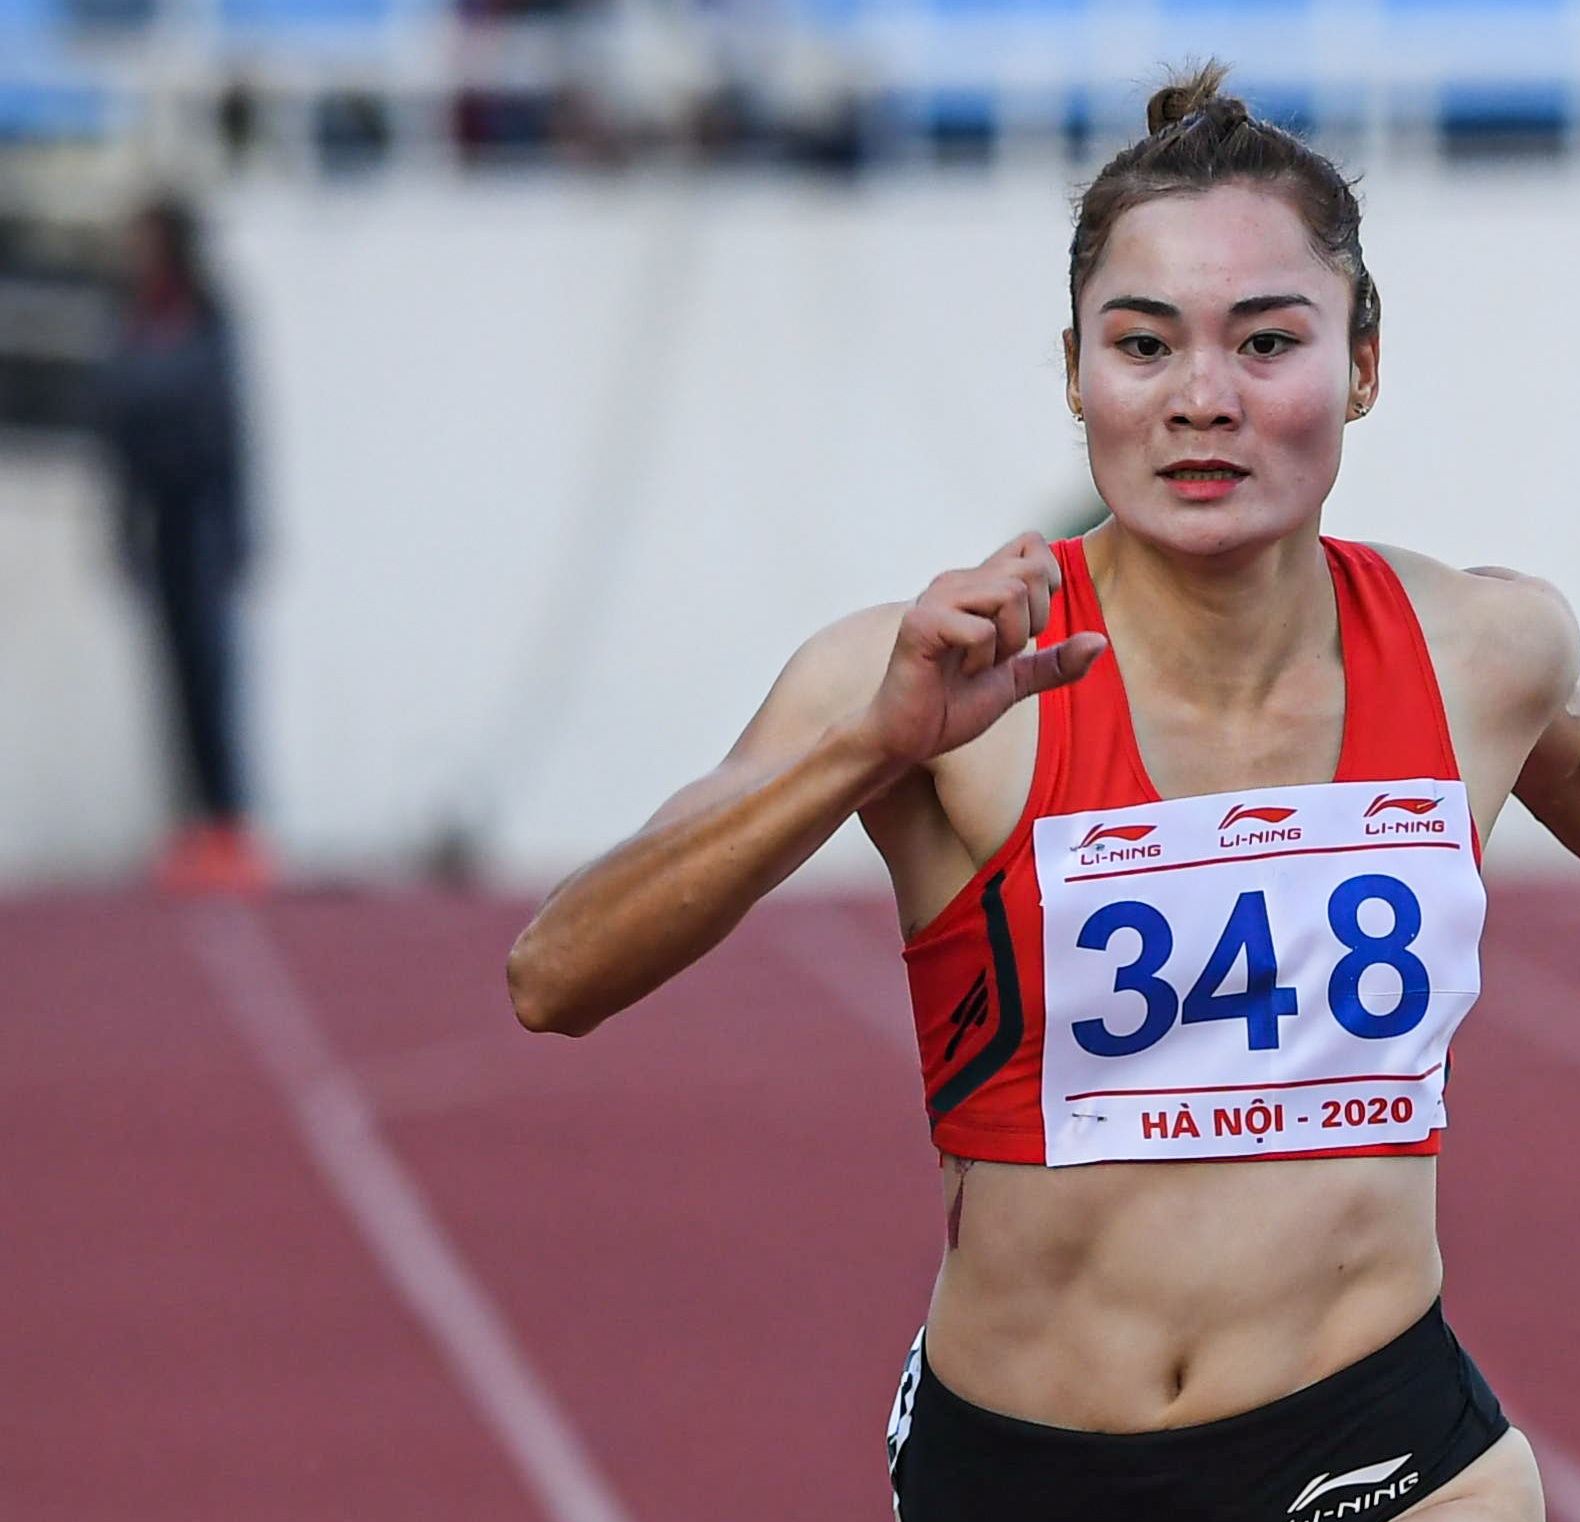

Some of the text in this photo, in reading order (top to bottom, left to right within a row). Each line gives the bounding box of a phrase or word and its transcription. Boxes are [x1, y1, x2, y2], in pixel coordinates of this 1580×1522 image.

[1080, 819, 1445, 867] LI-NING LI-NING LI-NING
[1071, 873, 1431, 1058] 348
[1141, 1102, 1201, 1140] HÀ
[1213, 1098, 1284, 1144] NỘI
[1321, 1096, 1414, 1129] 2020
